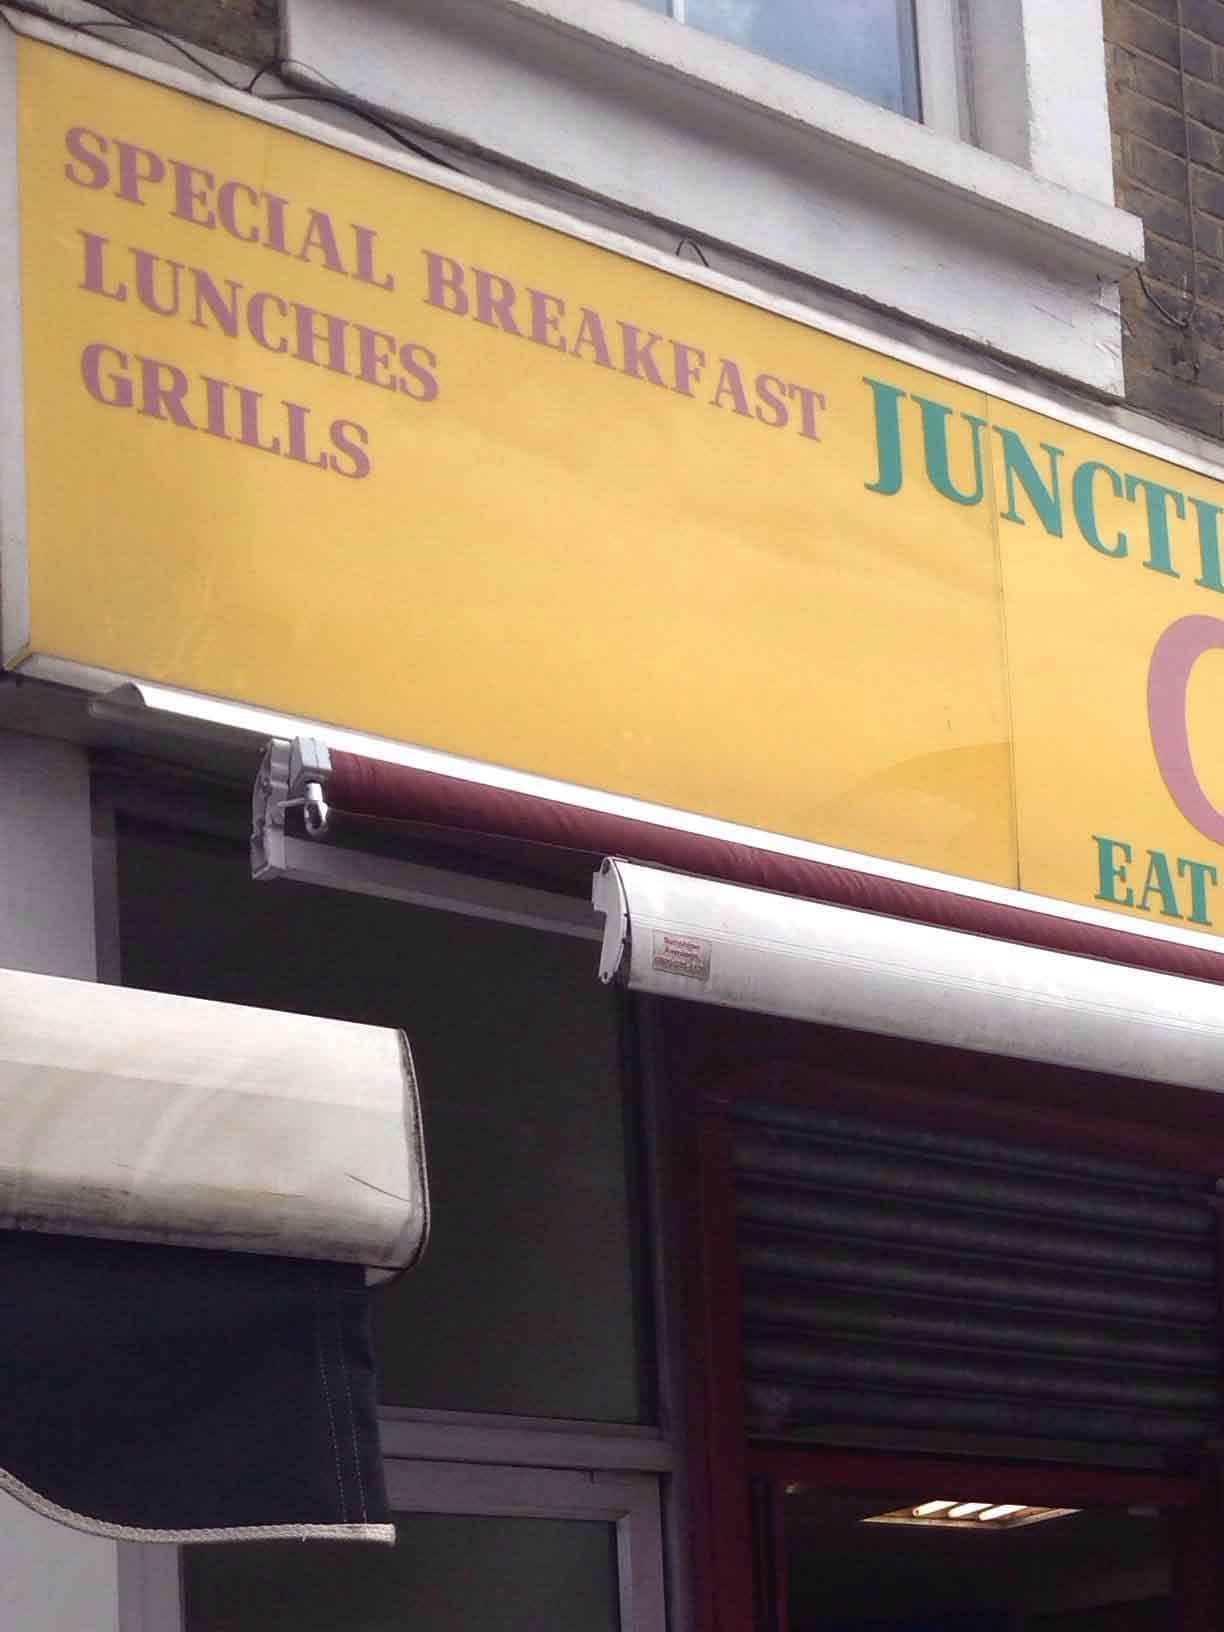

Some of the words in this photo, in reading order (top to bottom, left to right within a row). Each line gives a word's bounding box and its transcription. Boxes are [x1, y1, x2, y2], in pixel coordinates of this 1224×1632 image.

[63, 126, 395, 292] SPECIAL
[421, 248, 827, 443] BREAKFAST
[76, 230, 440, 402] LUNCHES
[81, 342, 371, 480] GRILLS
[1091, 834, 1218, 927] EAT
